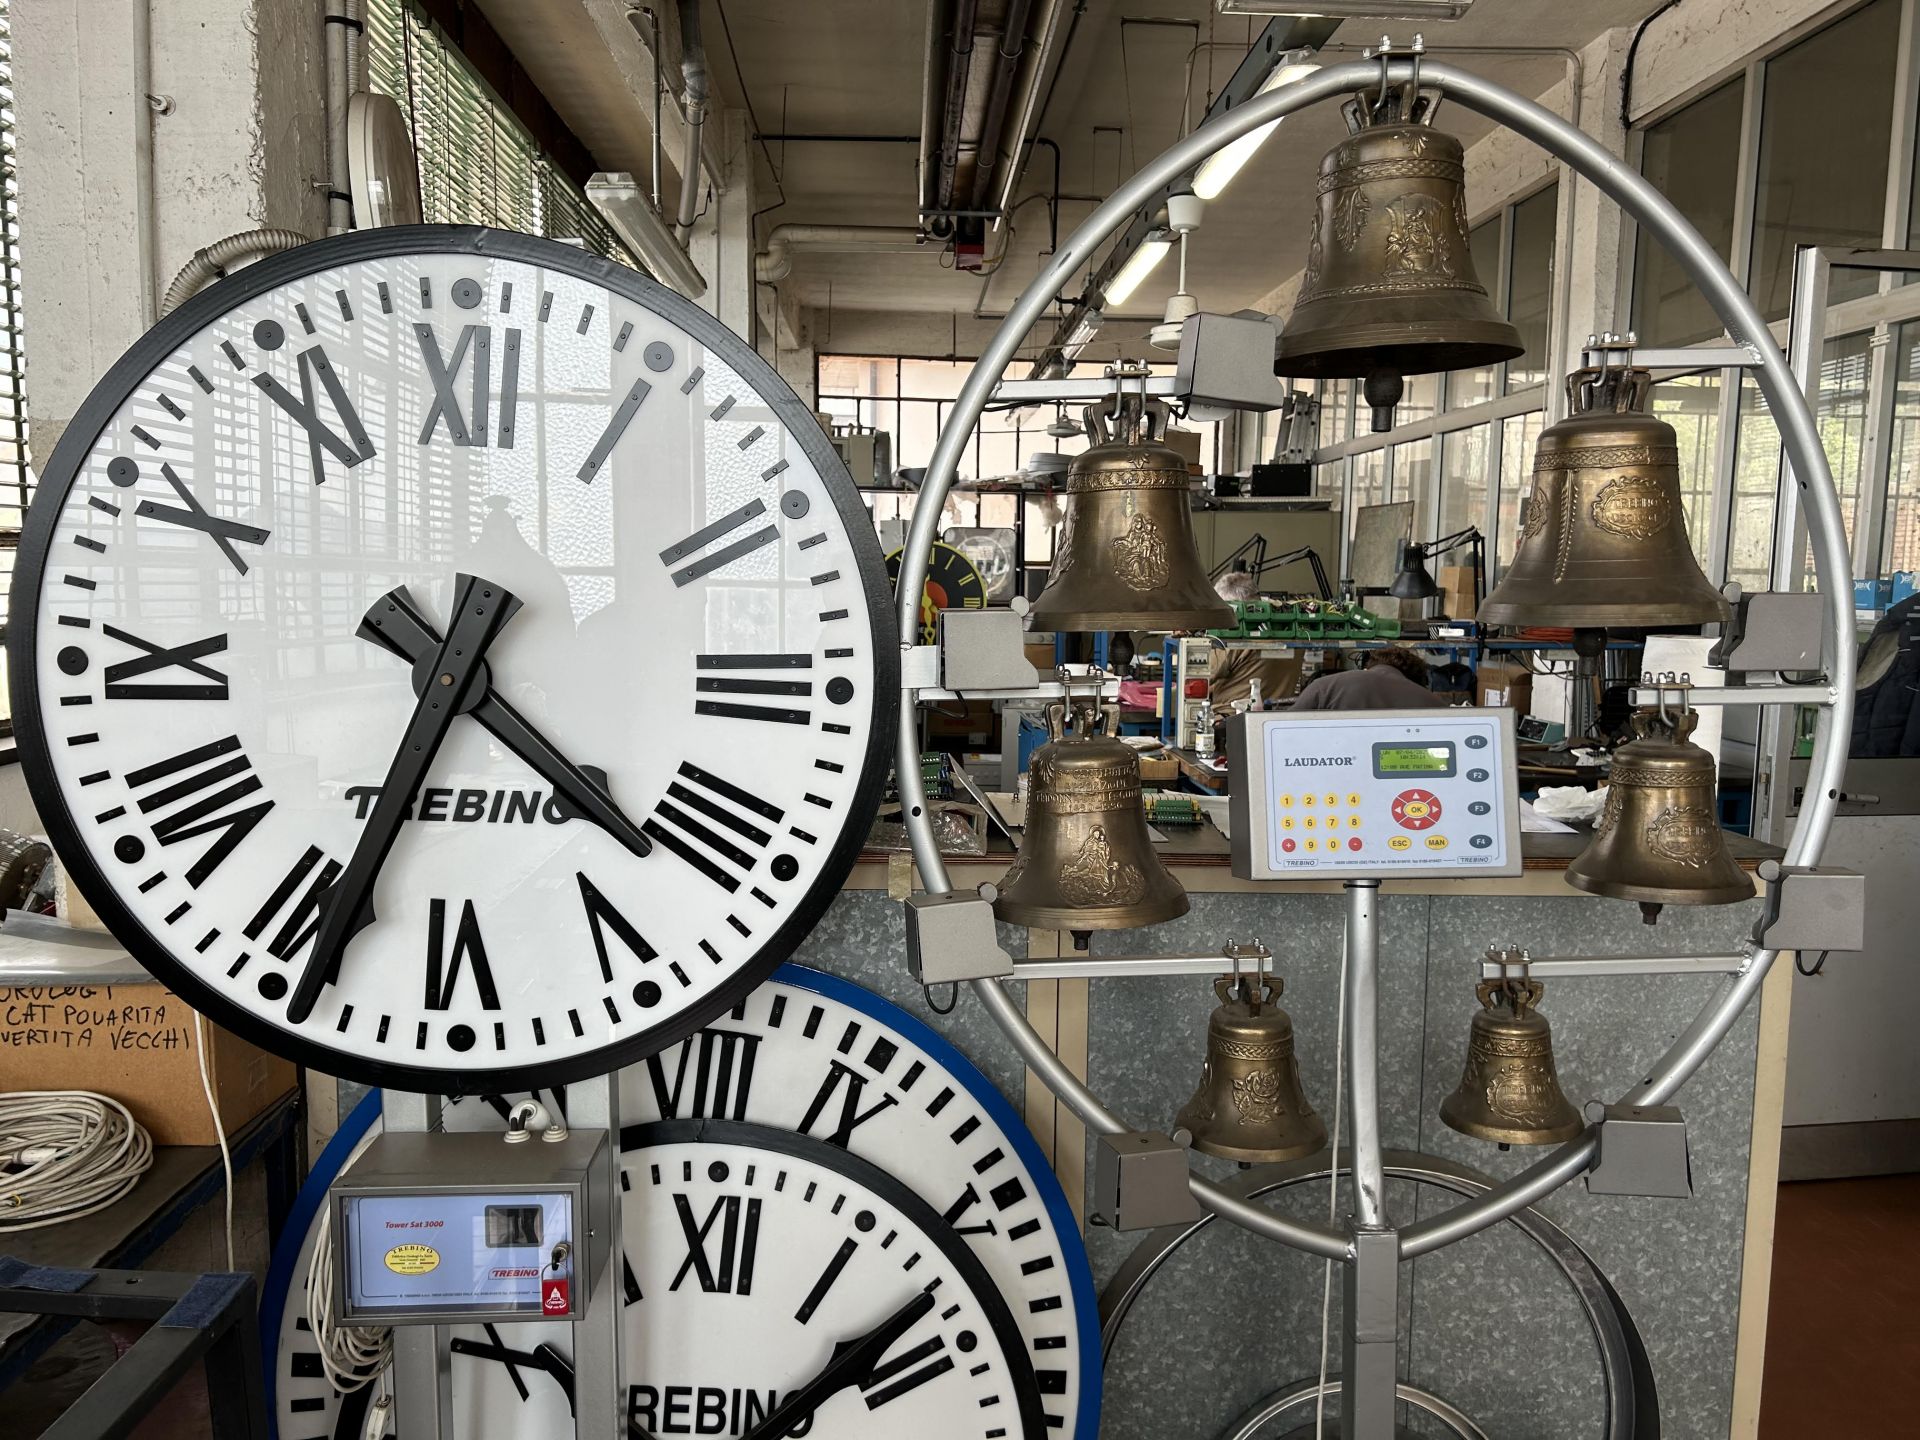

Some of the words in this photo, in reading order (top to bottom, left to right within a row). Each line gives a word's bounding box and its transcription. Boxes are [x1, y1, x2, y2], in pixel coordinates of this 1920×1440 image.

[412, 323, 521, 448] XII
[1284, 757, 1353, 767] LAUDATOR
[344, 786, 572, 825] TEBINO
[111, 1026, 189, 1050] VECCHI
[424, 1220, 444, 1228] 3000
[393, 1245, 433, 1254] TREBINO
[492, 1269, 539, 1278] TREBINO
[628, 1384, 815, 1439] REBINO
